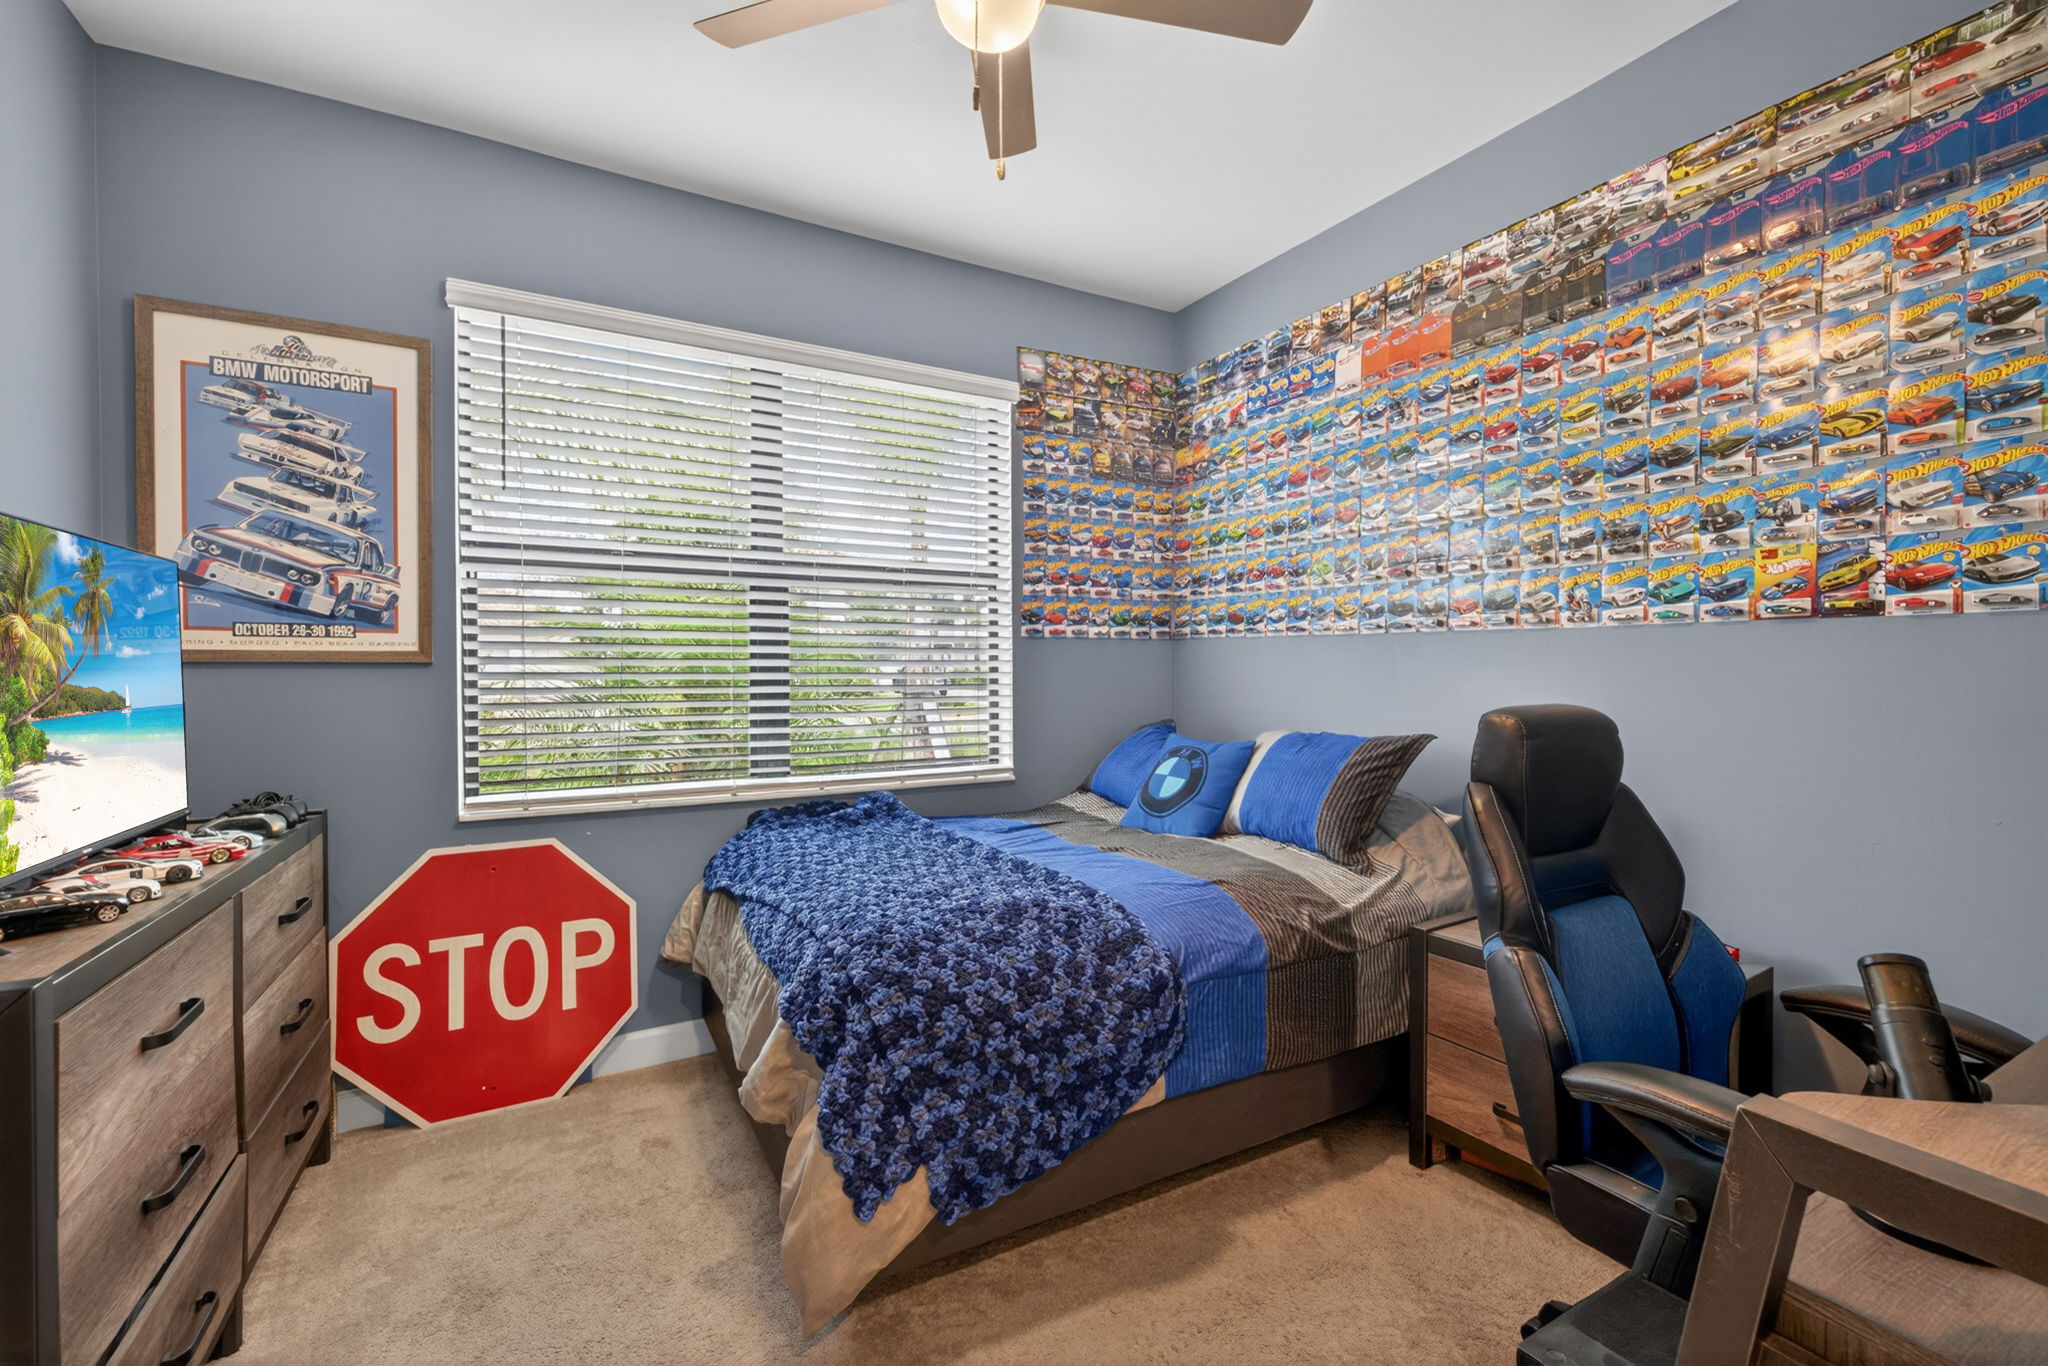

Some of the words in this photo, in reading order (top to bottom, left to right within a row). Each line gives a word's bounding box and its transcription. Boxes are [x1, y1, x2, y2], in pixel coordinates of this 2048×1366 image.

[213, 358, 257, 378] BMW
[263, 365, 369, 393] MOTORSPORT
[235, 623, 289, 636] OCTOBER
[356, 917, 615, 1044] STOP
